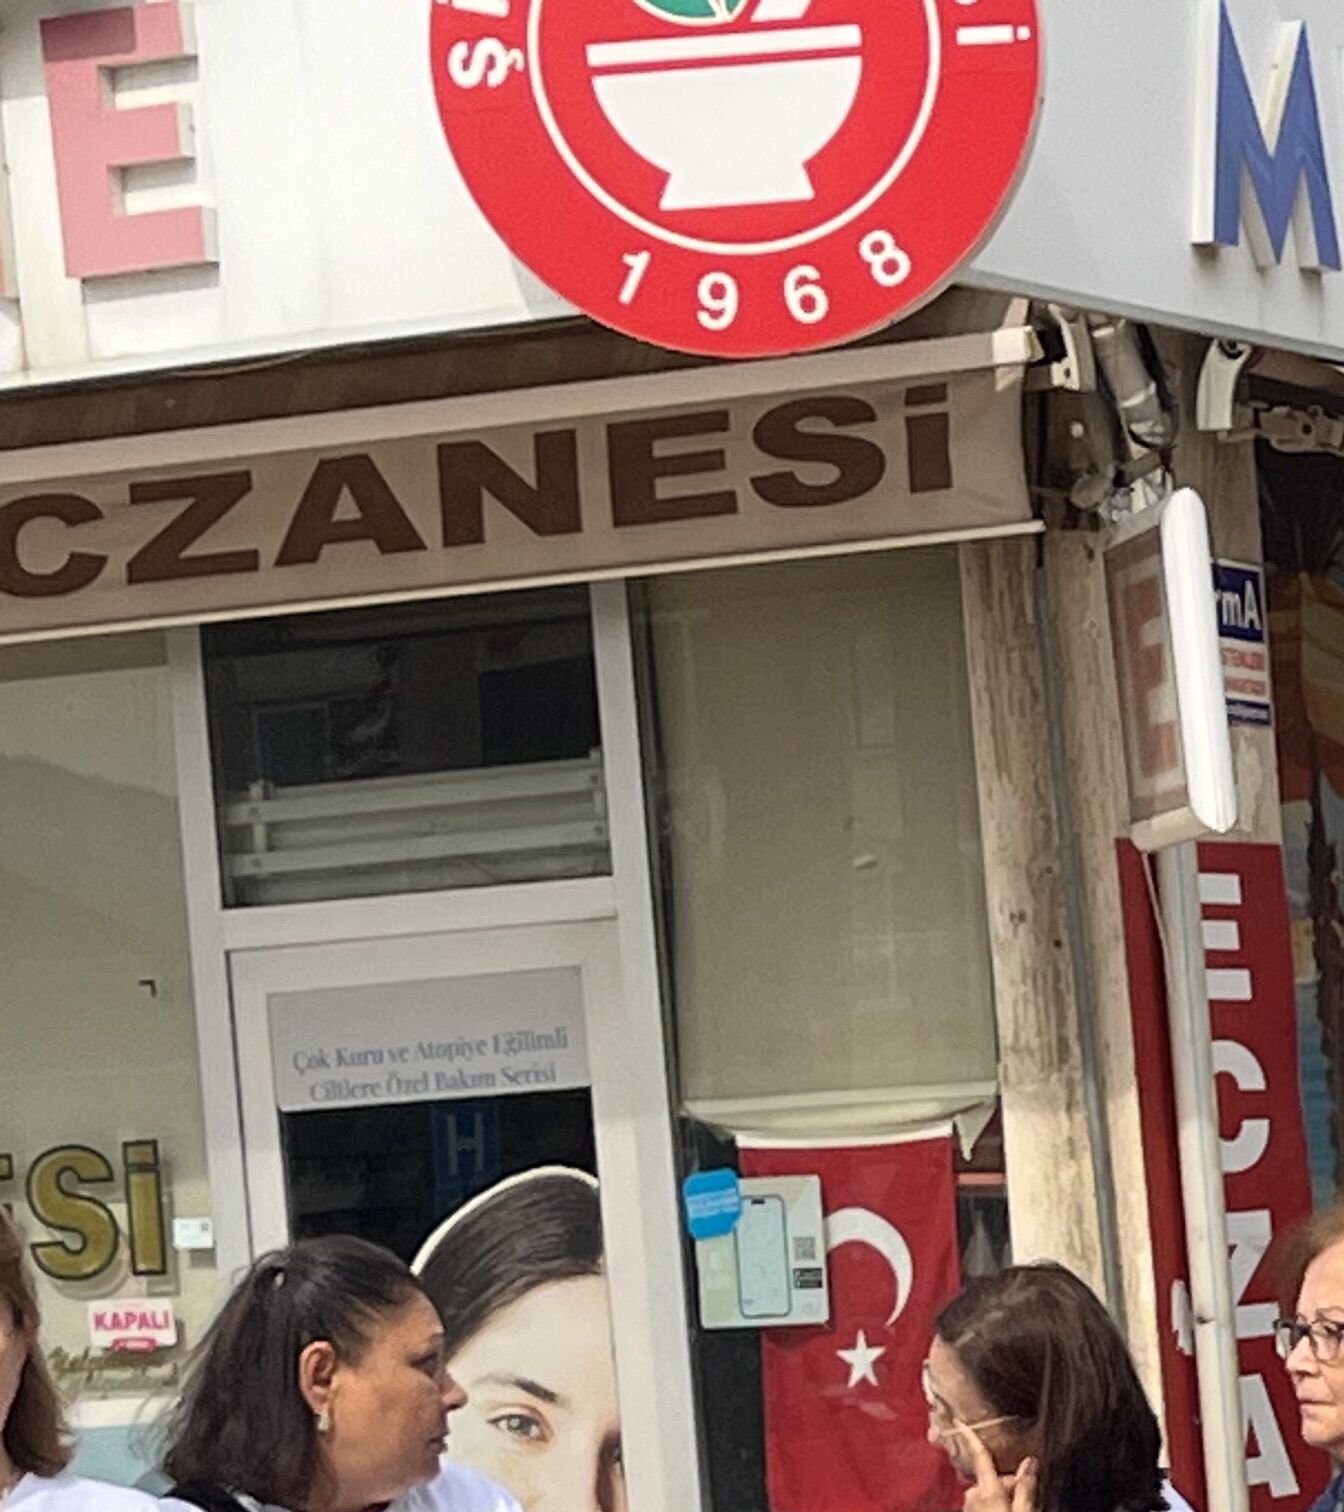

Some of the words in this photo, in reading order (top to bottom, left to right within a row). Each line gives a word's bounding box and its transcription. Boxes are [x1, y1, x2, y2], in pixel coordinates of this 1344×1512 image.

[617, 229, 912, 332] 1968
[292, 1051, 331, 1076] Çok
[336, 1047, 385, 1069] Kuru
[386, 1047, 410, 1064] ve
[417, 1036, 488, 1064] Atopiye
[386, 1070, 430, 1096] Özel
[435, 1066, 497, 1091] Bakım
[501, 1060, 557, 1085] Serisi
[0, 1139, 167, 1281] Sİ
[93, 1310, 170, 1331] KAPALI
